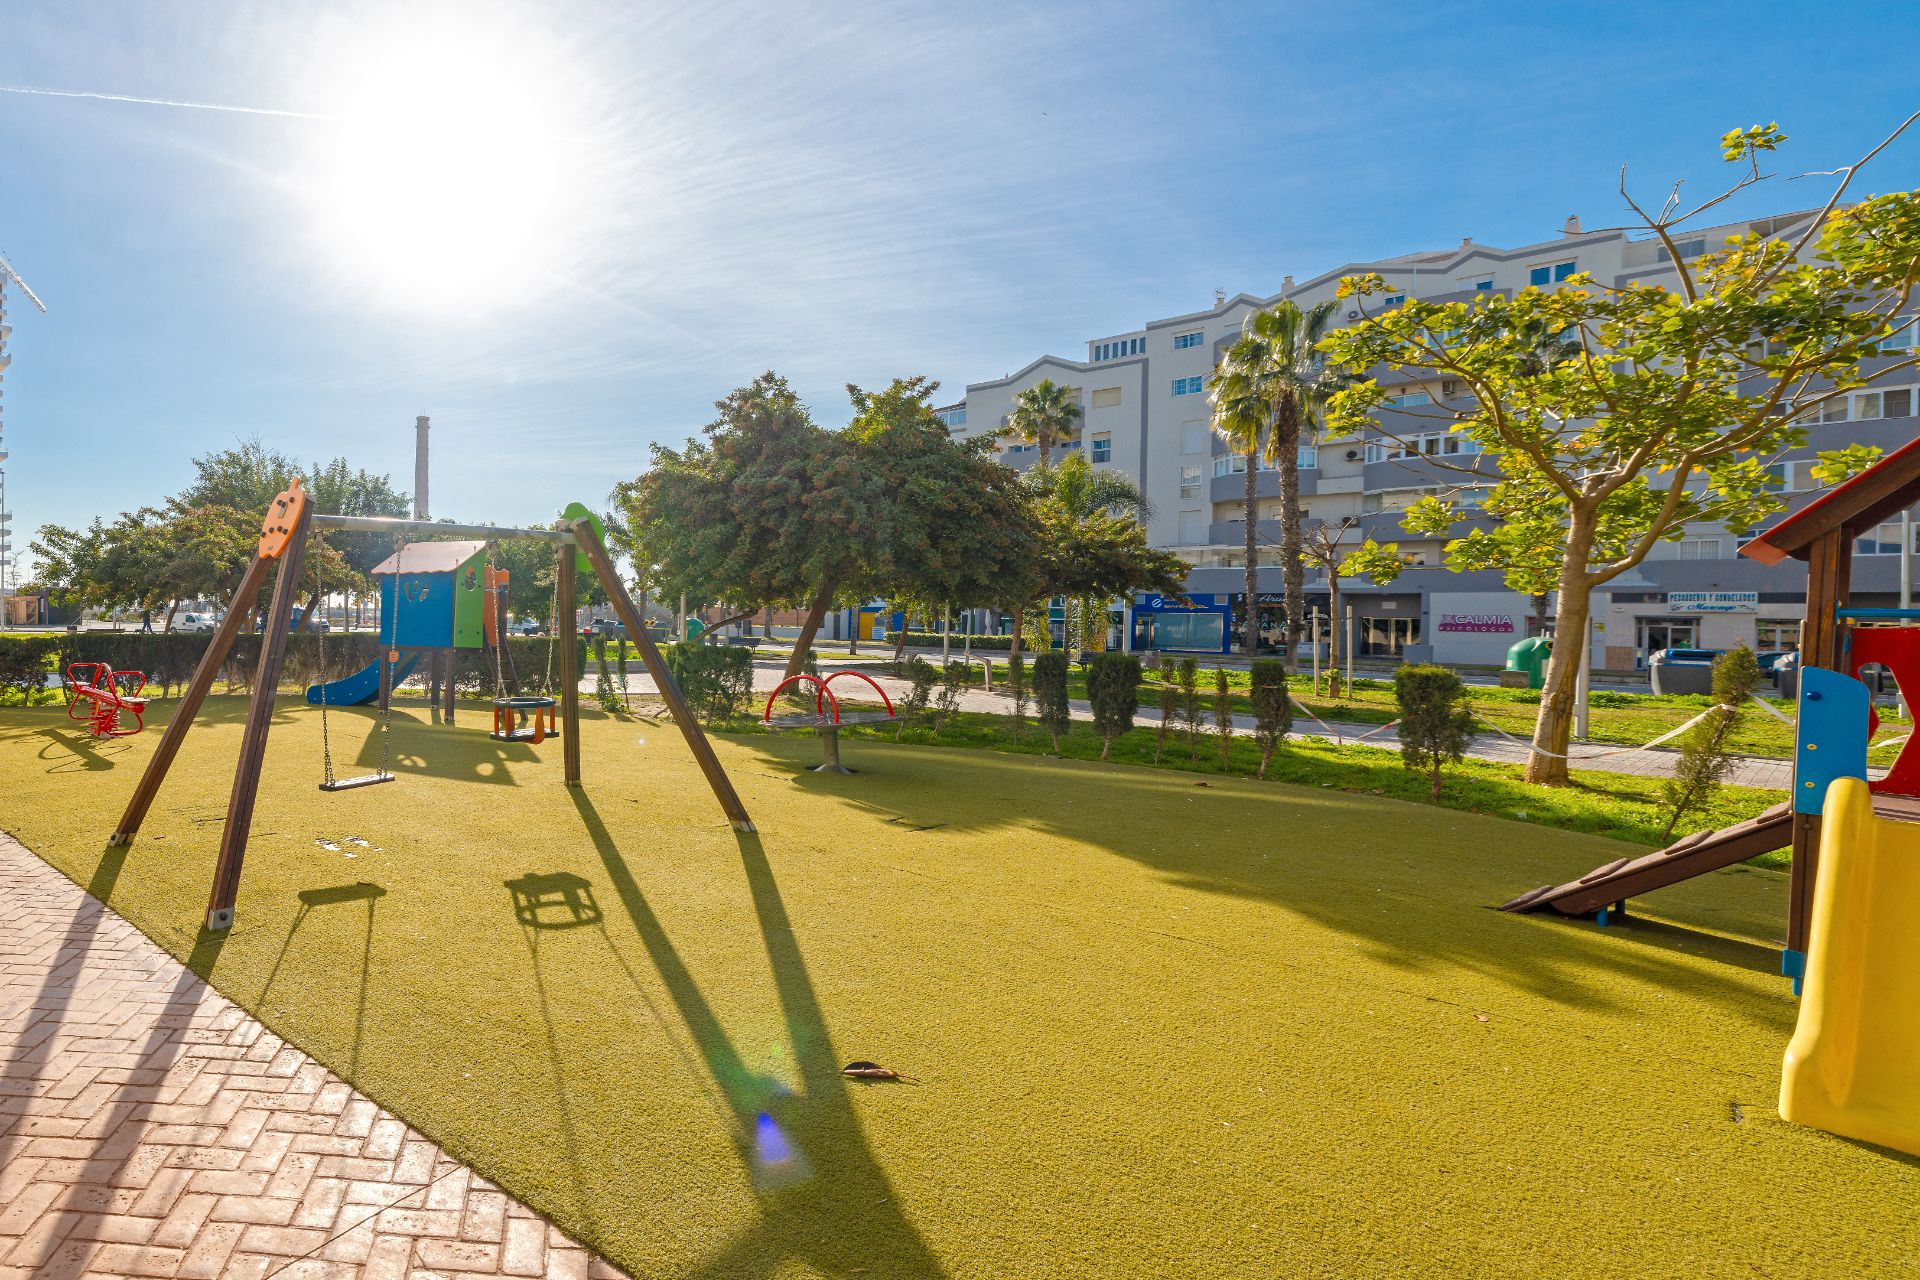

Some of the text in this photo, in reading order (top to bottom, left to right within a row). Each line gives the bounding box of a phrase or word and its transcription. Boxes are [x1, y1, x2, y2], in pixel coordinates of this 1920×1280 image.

[1709, 593, 1714, 601] Y
[1715, 593, 1756, 602] CONGELADOS
[1455, 615, 1512, 625] CALMIA
